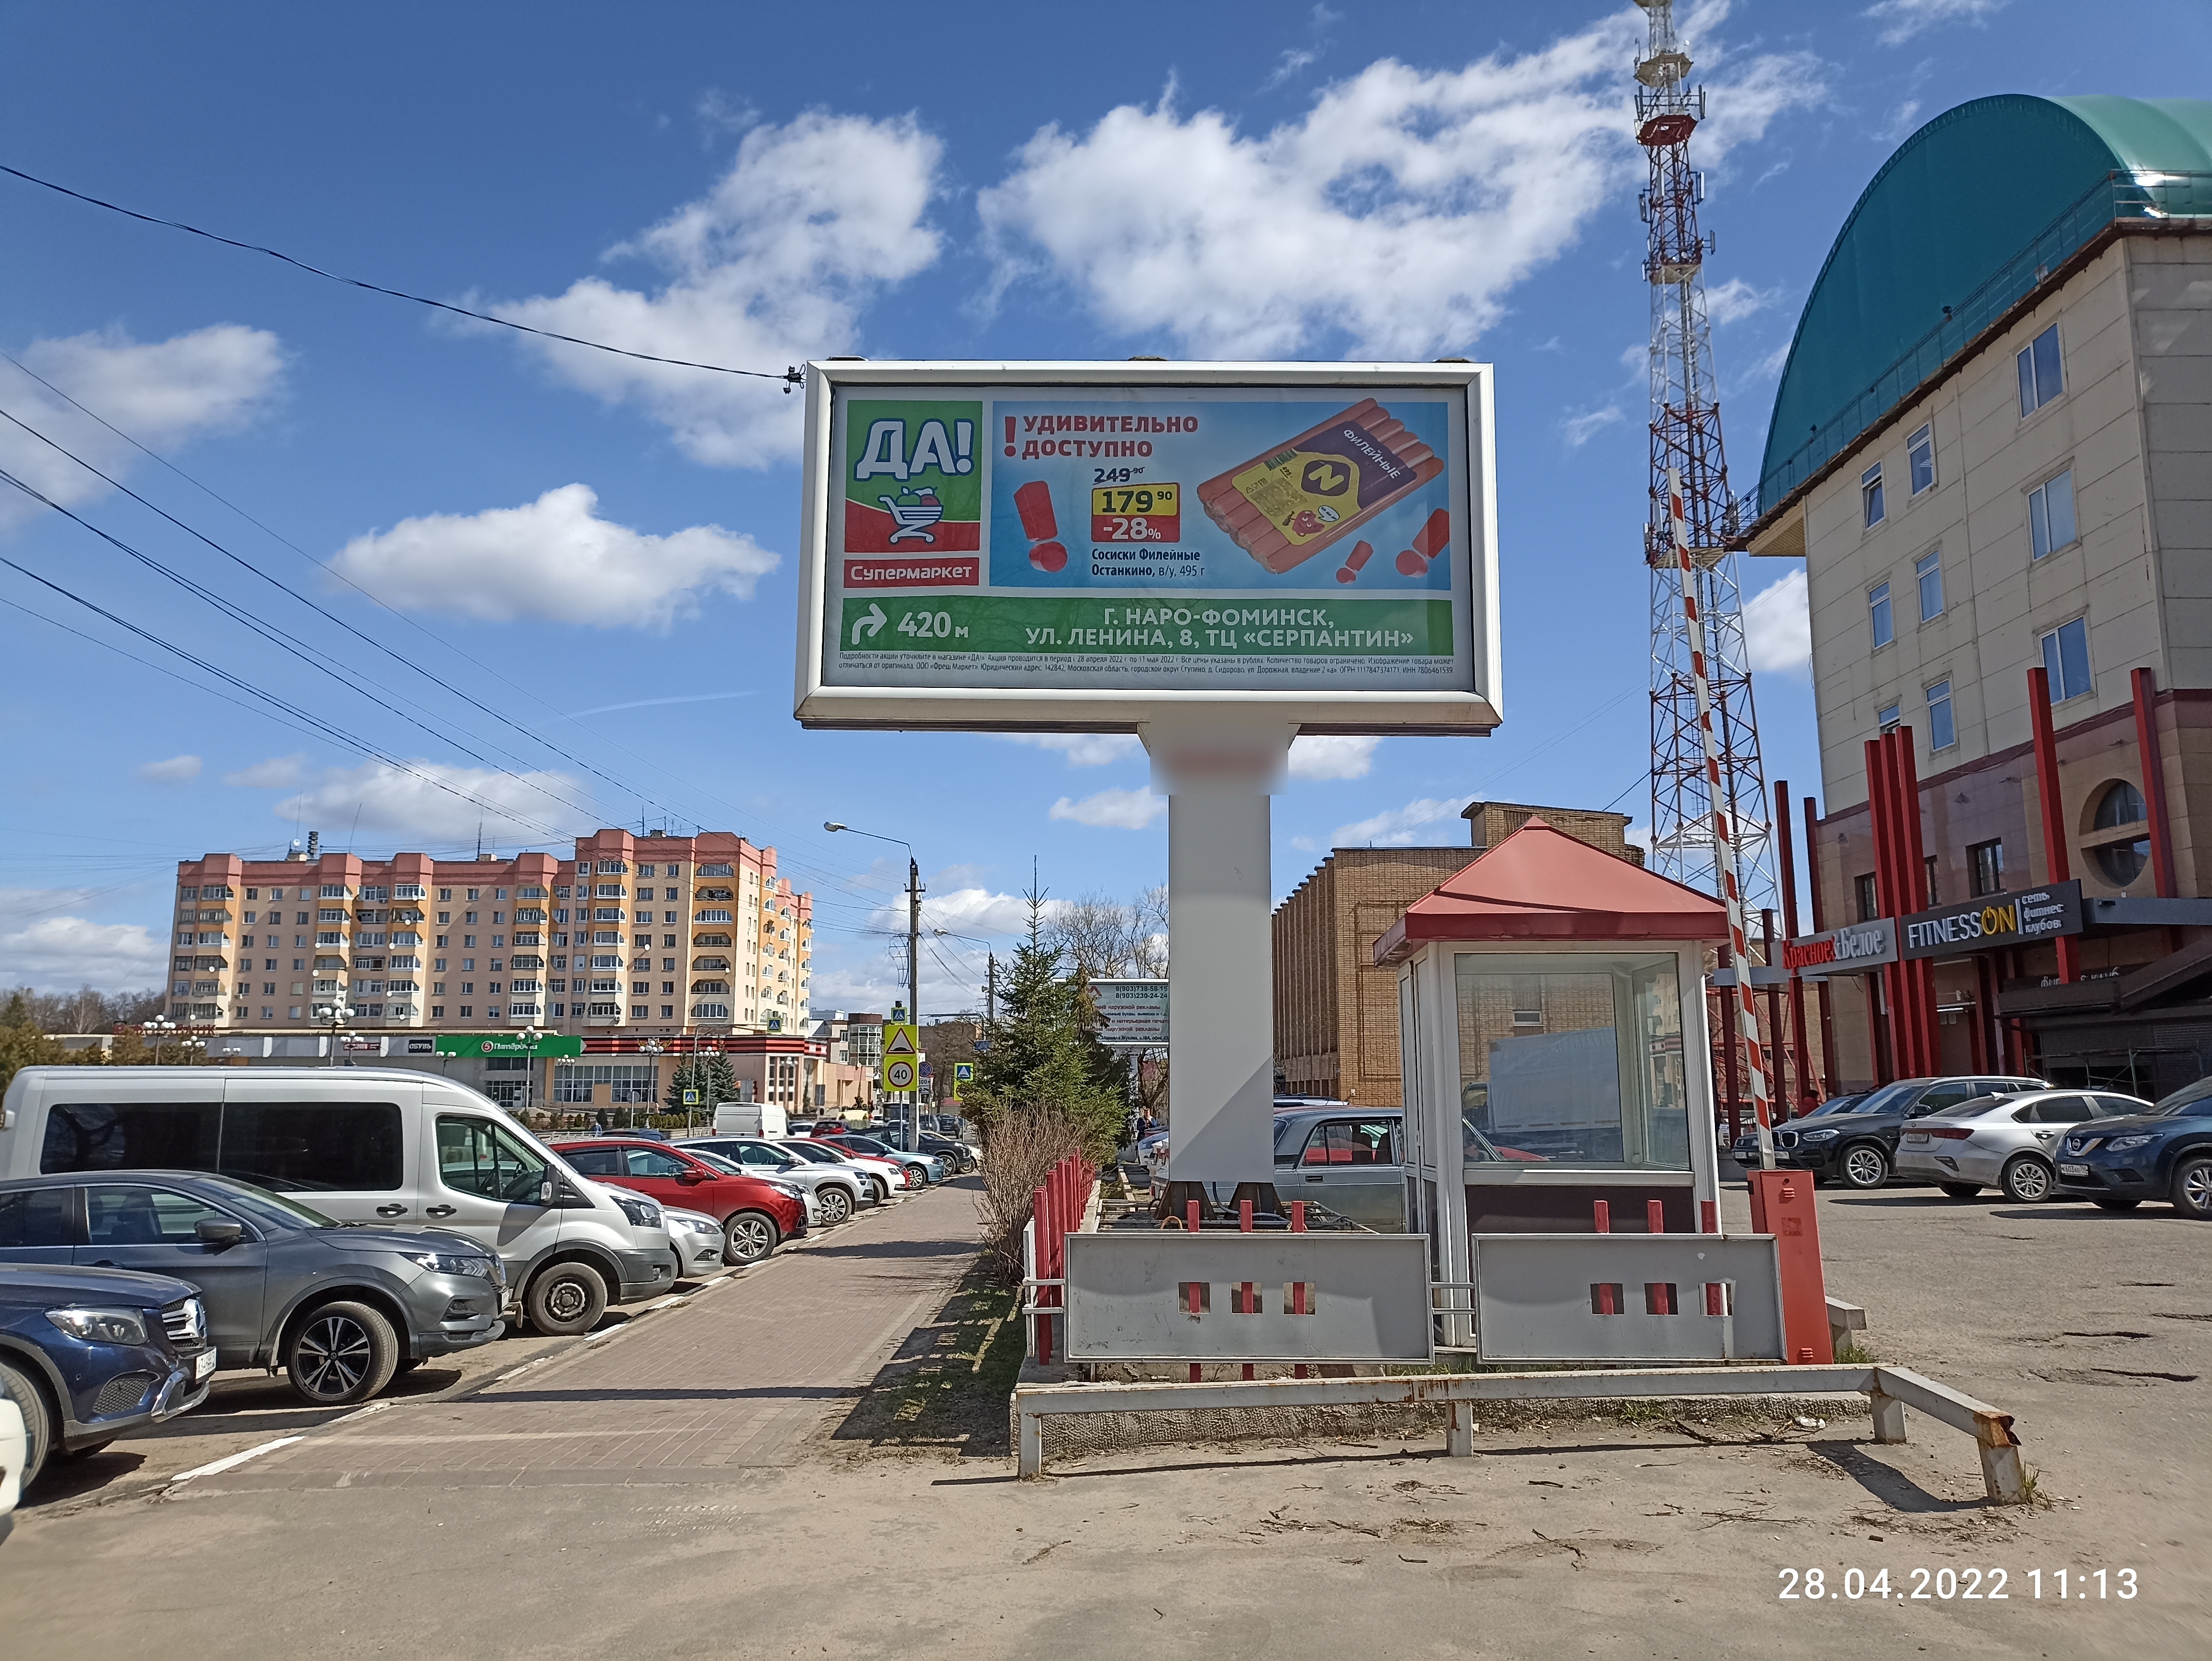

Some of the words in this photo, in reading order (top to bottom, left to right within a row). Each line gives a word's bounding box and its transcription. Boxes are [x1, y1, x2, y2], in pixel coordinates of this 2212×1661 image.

[1023, 416, 1198, 435] УДИВИТЕЛЬНО
[853, 418, 974, 482] ДА!
[1022, 440, 1152, 460] ДОСТУПНО
[1344, 429, 1400, 479] ФИЛЕЙНЫЕ
[1093, 468, 1131, 483] 249
[1102, 490, 1153, 513] 179
[1157, 491, 1172, 500] 90
[1103, 517, 1161, 540] -28%
[1092, 548, 1136, 560] Сосиски
[1139, 548, 1200, 561] Филейные
[851, 566, 972, 580] Супермаркет
[1092, 564, 1155, 577] Останкино,
[1158, 565, 1177, 578] в/у,
[1180, 565, 1197, 576] 495
[1201, 567, 1205, 576] г
[897, 611, 951, 638] 420
[955, 626, 968, 638] м
[1105, 608, 1118, 625] Г.
[1126, 609, 1334, 629] НАРО-ФОМИНСК,
[1025, 628, 1062, 645] УЛ.
[1068, 629, 1173, 648] ЛЕНИНА,
[1180, 629, 1200, 649] 8,
[1205, 630, 1237, 649] ТЦ
[1243, 630, 1414, 647] «СЕРПАНТИН»
[839, 652, 879, 661] Подробности
[899, 652, 931, 662] уточняйте
[988, 653, 1006, 663] Акция
[1007, 653, 1043, 663] проводится
[1077, 654, 1084, 663] 28
[1109, 655, 1123, 664] 2022
[1181, 655, 1191, 664] Все
[1267, 655, 1302, 664] Количество
[1304, 658, 1328, 666] товаров
[1368, 656, 1410, 666] Изображение
[916, 662, 929, 670] ООО
[930, 662, 951, 671] «Фреш
[981, 663, 1023, 672] Юридический
[1067, 664, 1103, 672] Московская
[1104, 664, 1129, 673] область,
[1181, 664, 1206, 674] Ступино,
[1215, 665, 1246, 674] Сидорово,
[1257, 665, 1290, 675] Дорожная,
[1339, 665, 1355, 674] ОГРН
[2022, 892, 2050, 904] сеть
[2024, 904, 2064, 921] фитнес
[1908, 905, 2016, 948] FITNESSON
[2025, 918, 2061, 934] клубов
[894, 1070, 907, 1079] 40
